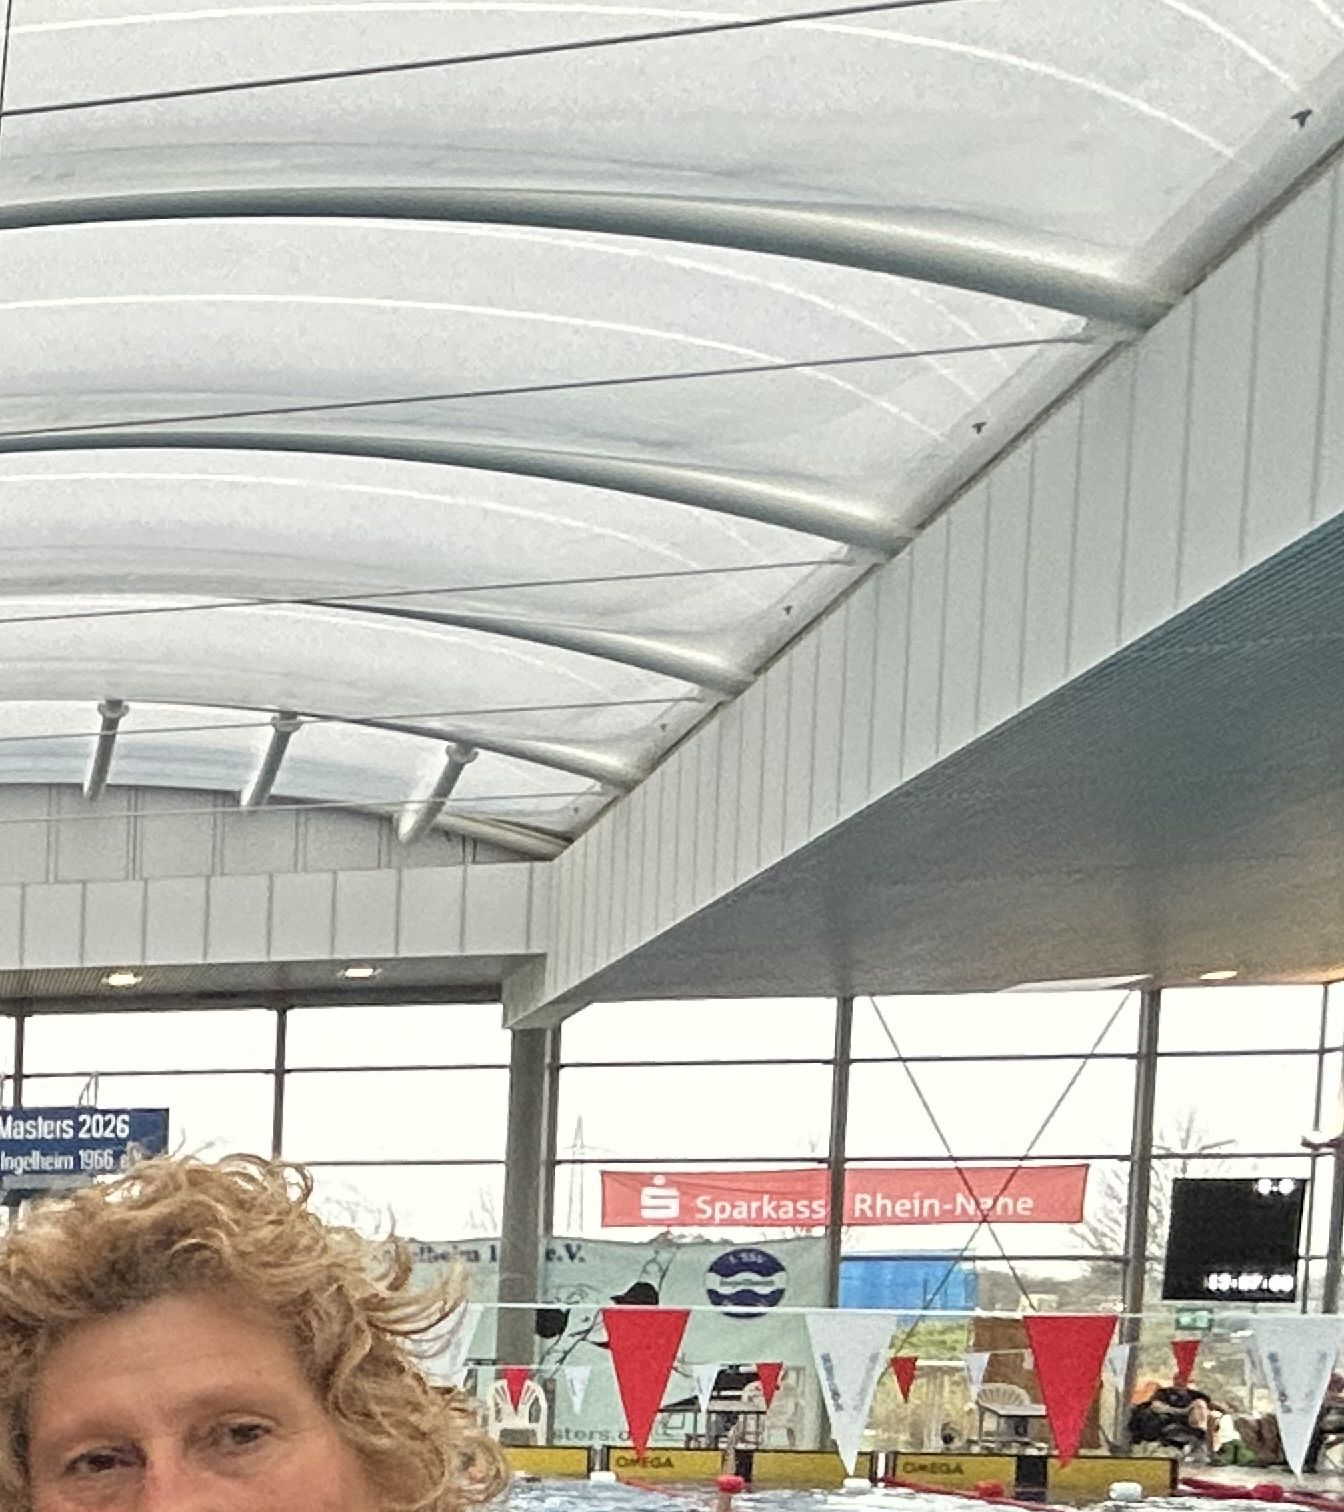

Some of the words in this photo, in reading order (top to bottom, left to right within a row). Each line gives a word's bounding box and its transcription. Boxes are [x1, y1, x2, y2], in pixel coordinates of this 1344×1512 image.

[78, 1114, 130, 1139] 2026
[0, 1150, 73, 1175] Ingelheim
[79, 1149, 113, 1169] 1966
[695, 1195, 826, 1223] Sparkass
